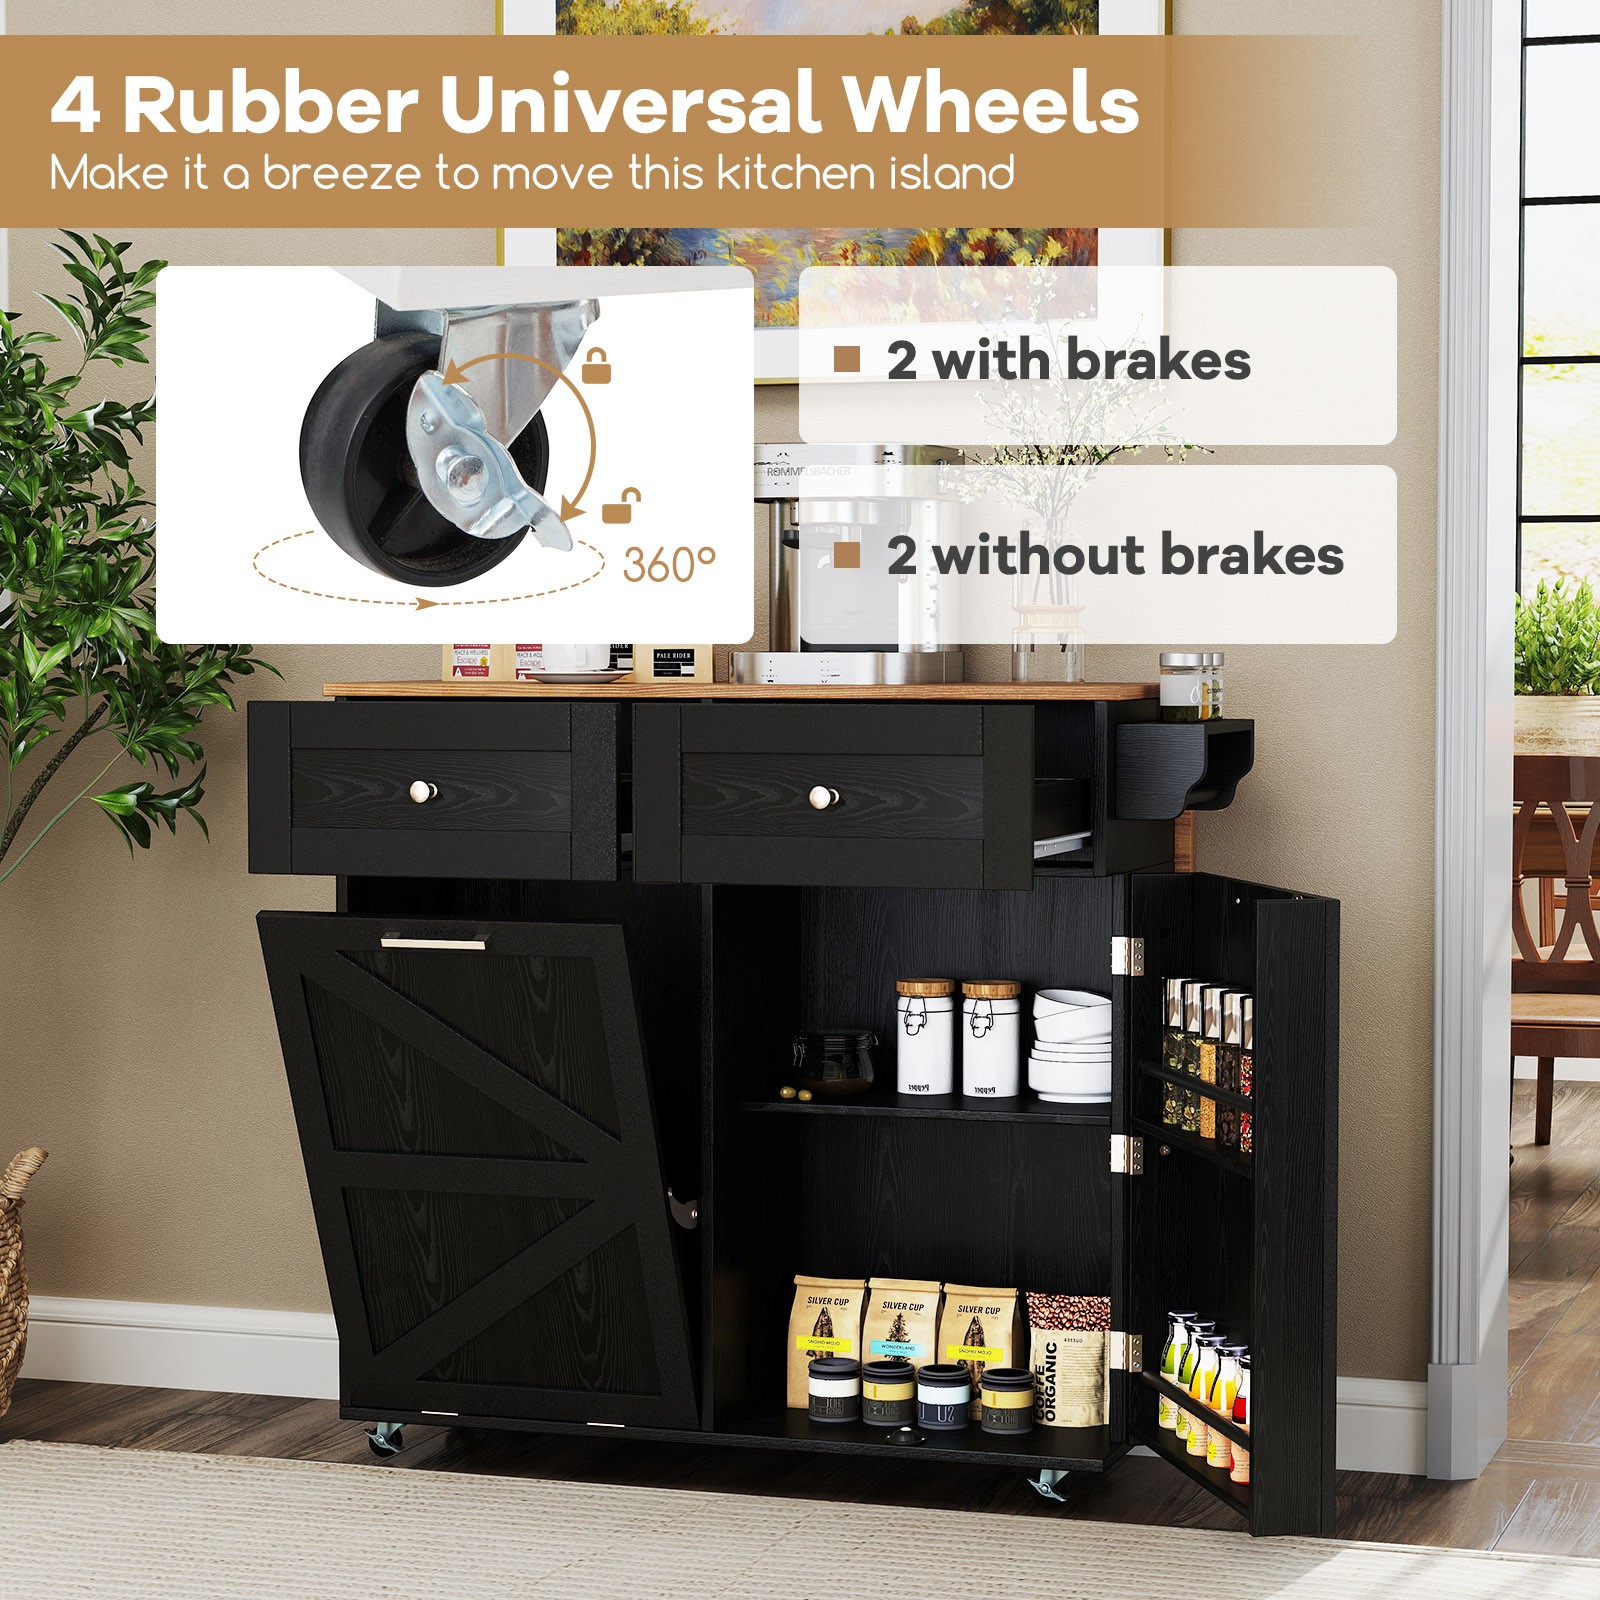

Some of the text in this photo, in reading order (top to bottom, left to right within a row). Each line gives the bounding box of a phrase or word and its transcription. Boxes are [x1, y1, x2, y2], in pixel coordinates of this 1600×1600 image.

[456, 656, 478, 664] Escape
[519, 659, 541, 667] Escape
[807, 1296, 850, 1306] SILVER CUP
[882, 1301, 908, 1311] SILVER
[908, 1303, 925, 1312] CUP
[957, 1305, 1001, 1315] SILVER CUP
[881, 1343, 916, 1352] WONDERLAND
[1045, 1341, 1058, 1423] ORGANIC
[1035, 1364, 1046, 1421] COFFE
